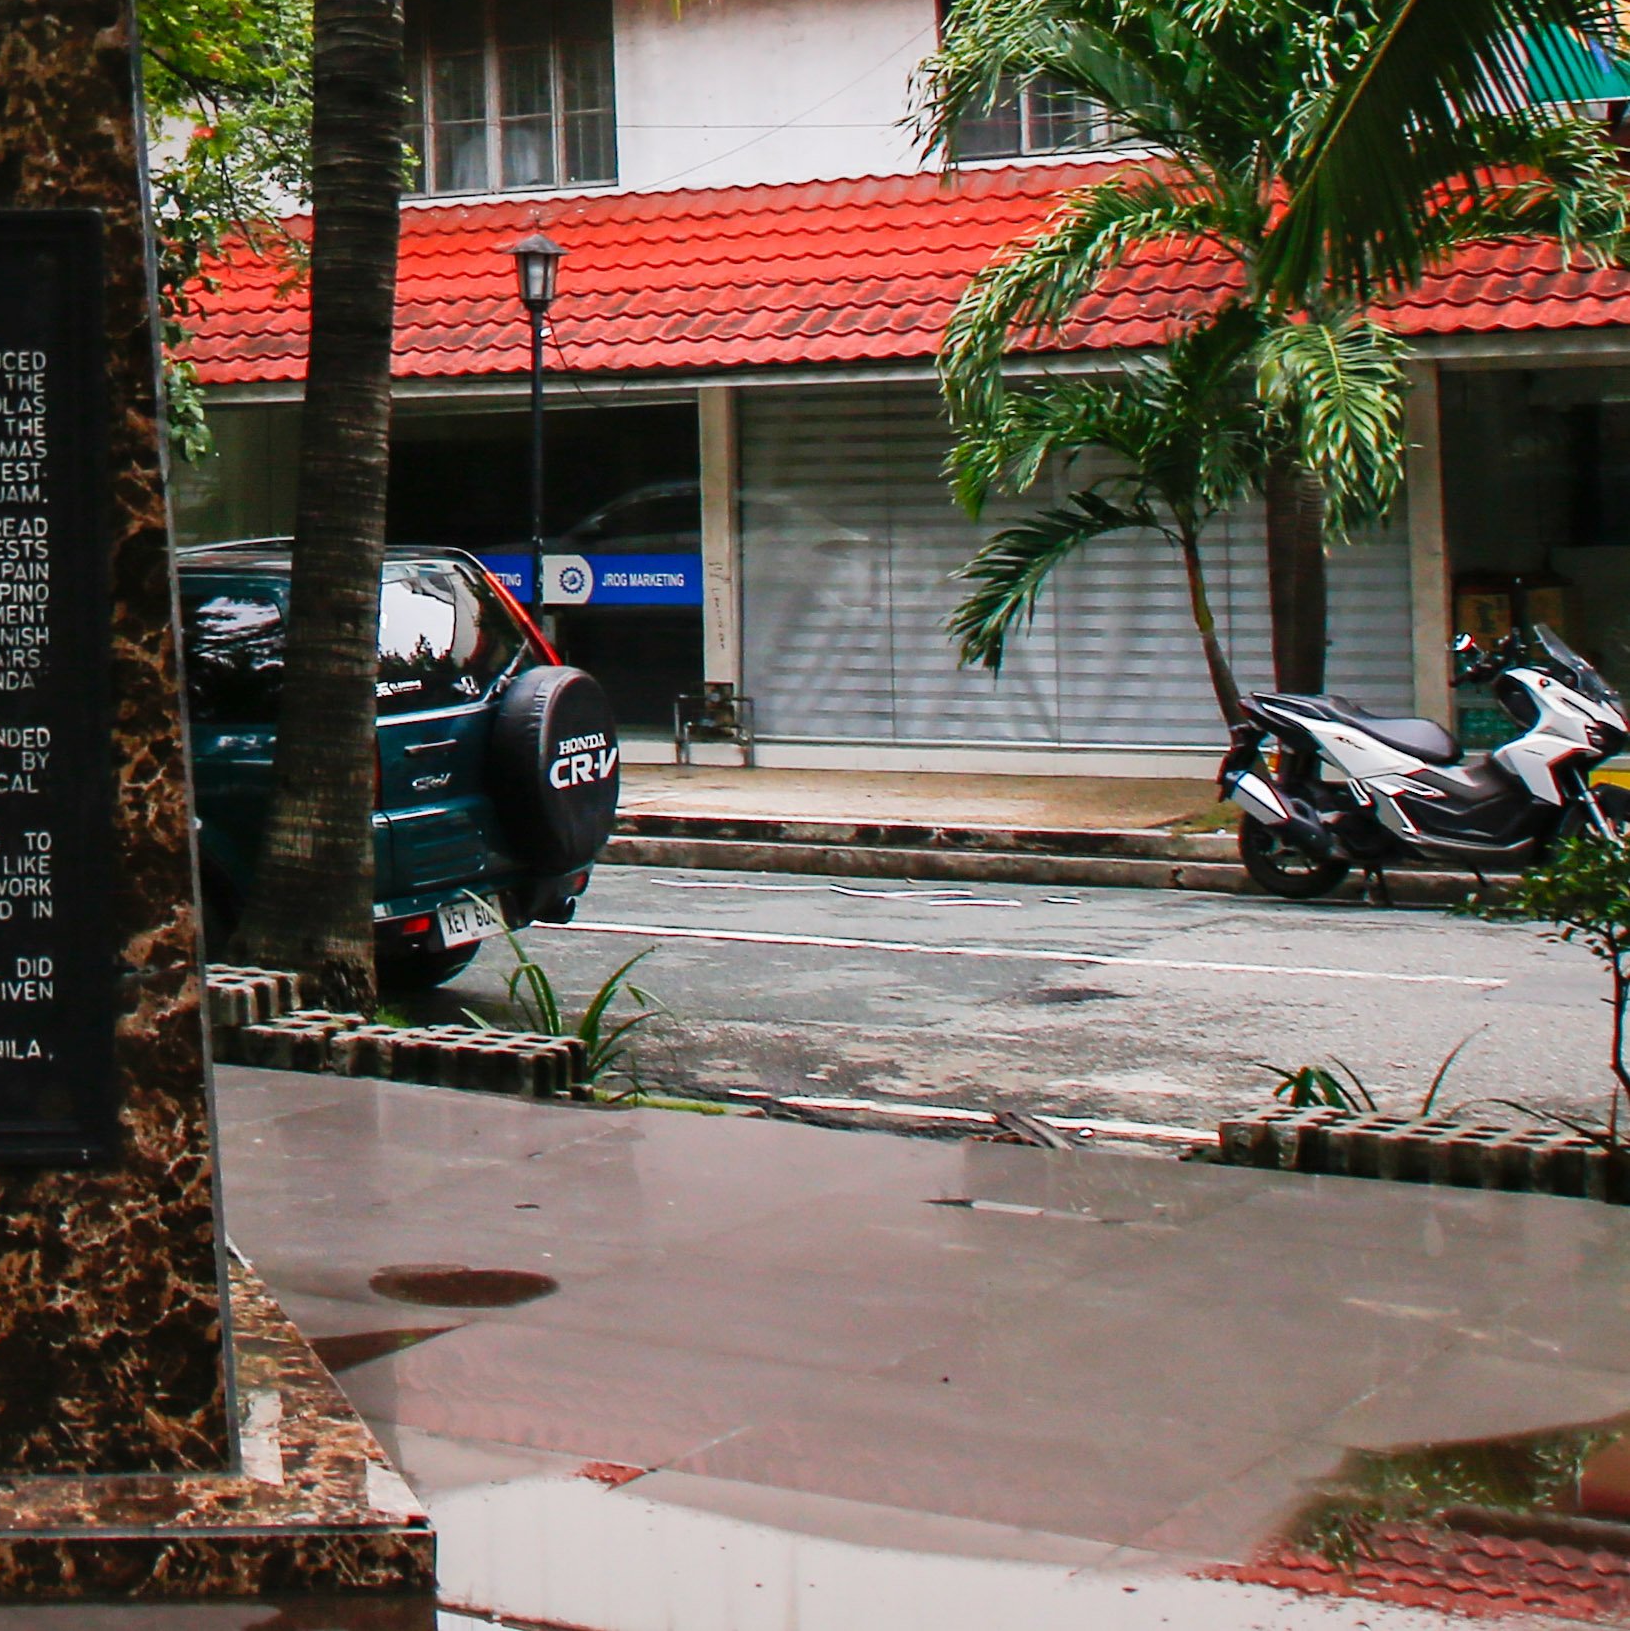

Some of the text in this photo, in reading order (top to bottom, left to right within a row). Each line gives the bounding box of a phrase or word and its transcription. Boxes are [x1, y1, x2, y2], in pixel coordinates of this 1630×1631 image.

[4, 372, 46, 392] THE
[4, 417, 47, 437] THE
[601, 573, 685, 587] JROG MARKETING
[559, 732, 607, 756] HONDA
[23, 832, 53, 853] TO
[3, 855, 52, 876] LIKE
[444, 902, 498, 935] XEY 60
[16, 957, 54, 979] DID
